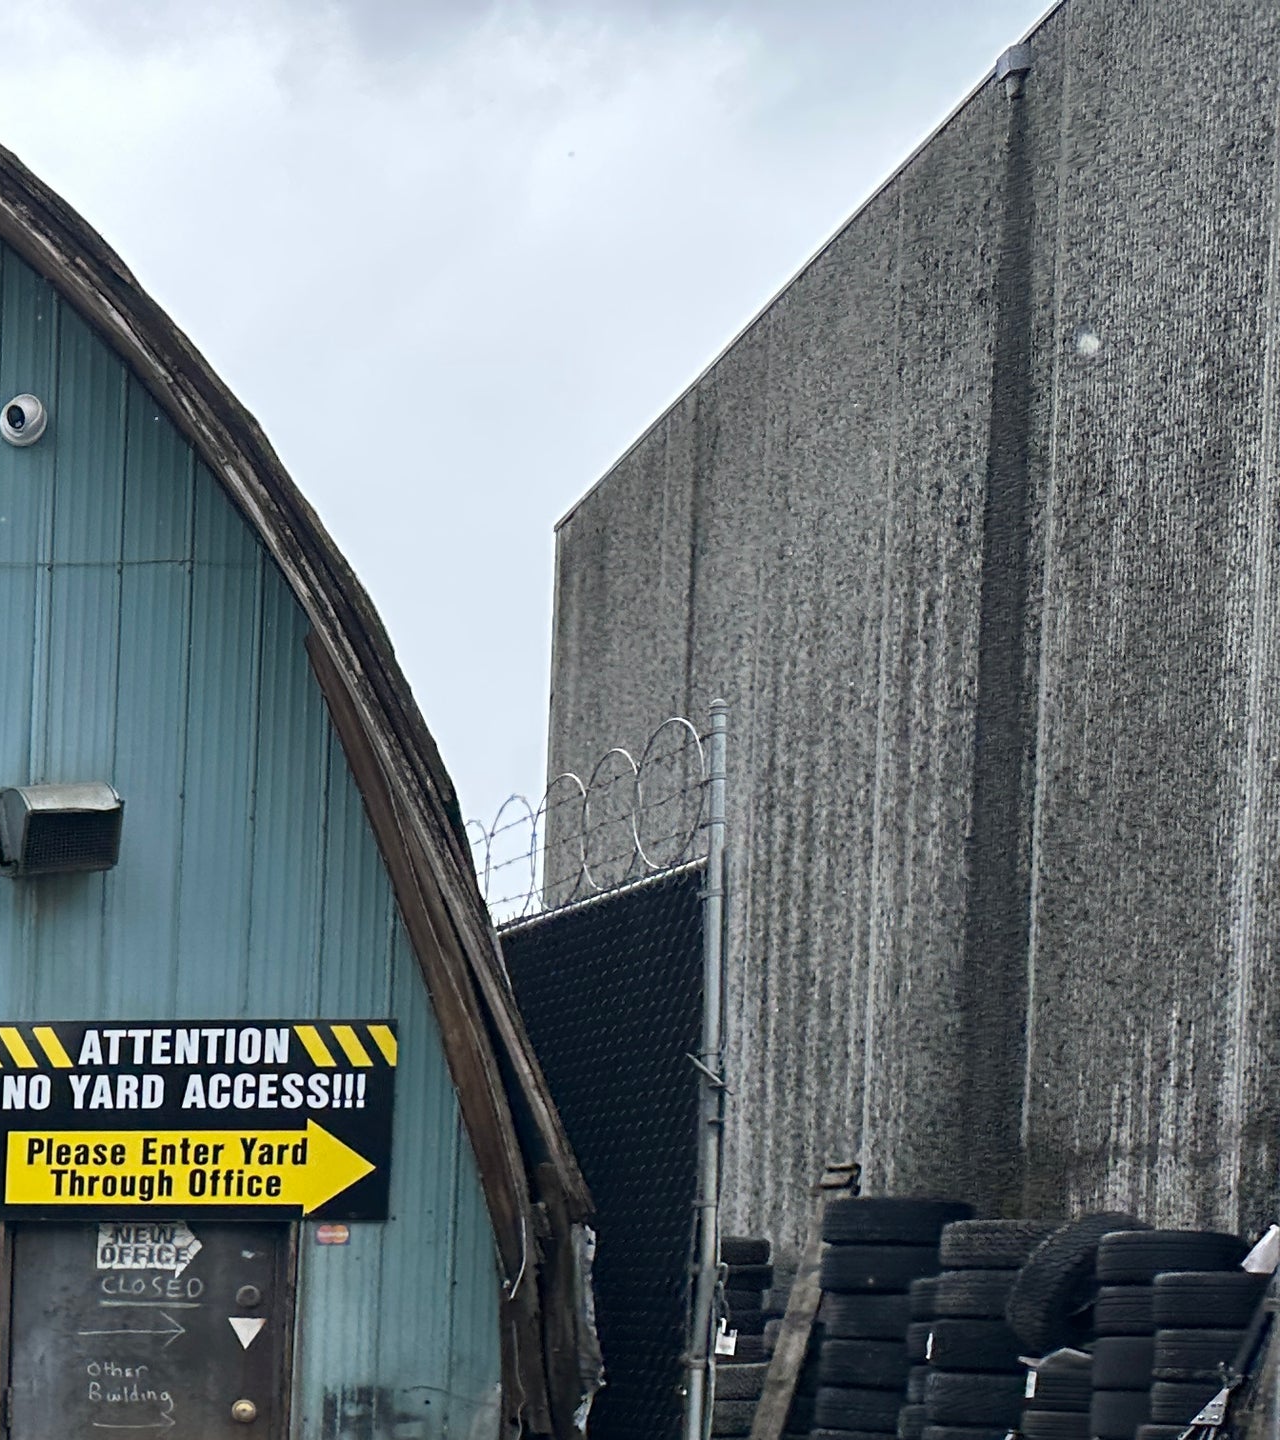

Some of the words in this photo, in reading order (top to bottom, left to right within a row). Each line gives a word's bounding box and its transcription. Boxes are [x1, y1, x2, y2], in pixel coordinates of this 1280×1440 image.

[78, 1026, 290, 1066] ATTENTION
[2, 1074, 52, 1110] NO
[67, 1073, 165, 1110] YARD
[180, 1072, 367, 1109] ACCESS!!!
[26, 1137, 127, 1166] Please
[141, 1137, 225, 1166] Enter
[240, 1136, 309, 1166] Yard
[50, 1169, 174, 1202] Through
[188, 1168, 282, 1197] Office
[111, 1226, 177, 1243] NEW
[100, 1243, 189, 1265] OFFICE
[101, 1275, 204, 1298] CLOSED
